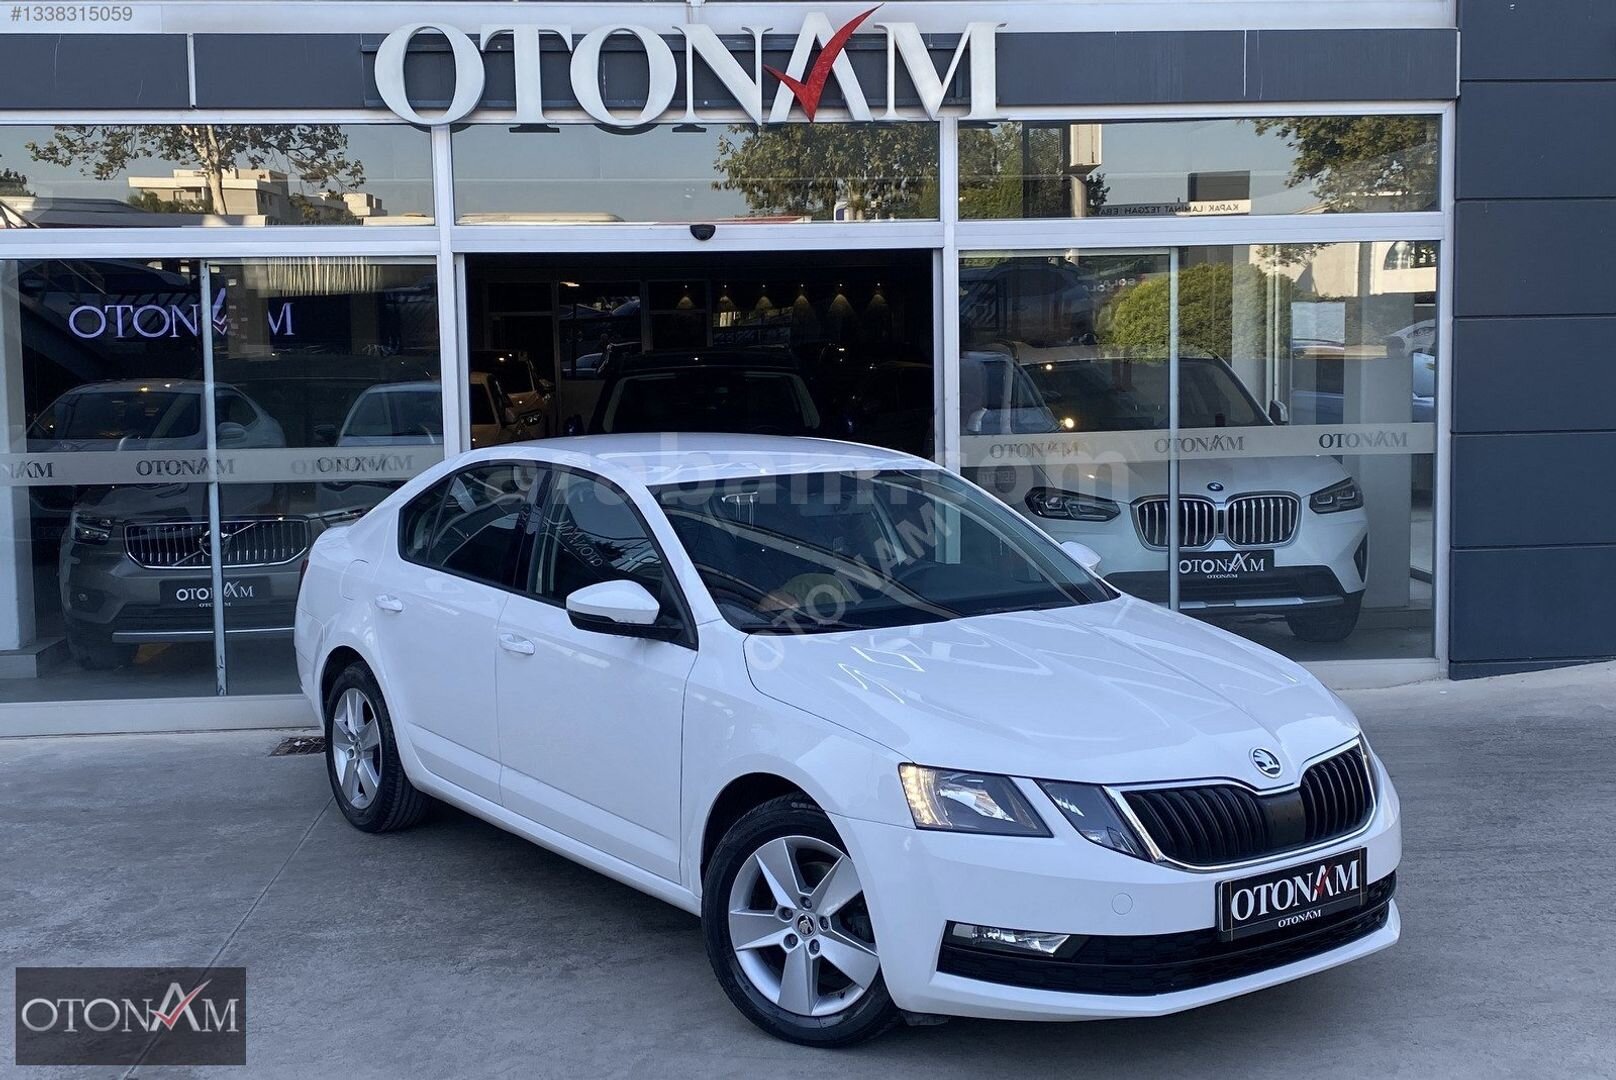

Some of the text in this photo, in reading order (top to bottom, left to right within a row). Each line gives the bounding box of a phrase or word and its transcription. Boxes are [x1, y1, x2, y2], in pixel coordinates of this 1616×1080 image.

[374, 10, 1007, 127] OTONAM
[1318, 431, 1408, 448] OTONAM
[1179, 553, 1265, 574] OTONAM
[176, 581, 254, 601] OTOAM
[1231, 860, 1360, 921] OTONAM
[1278, 909, 1322, 928] OTONAM
